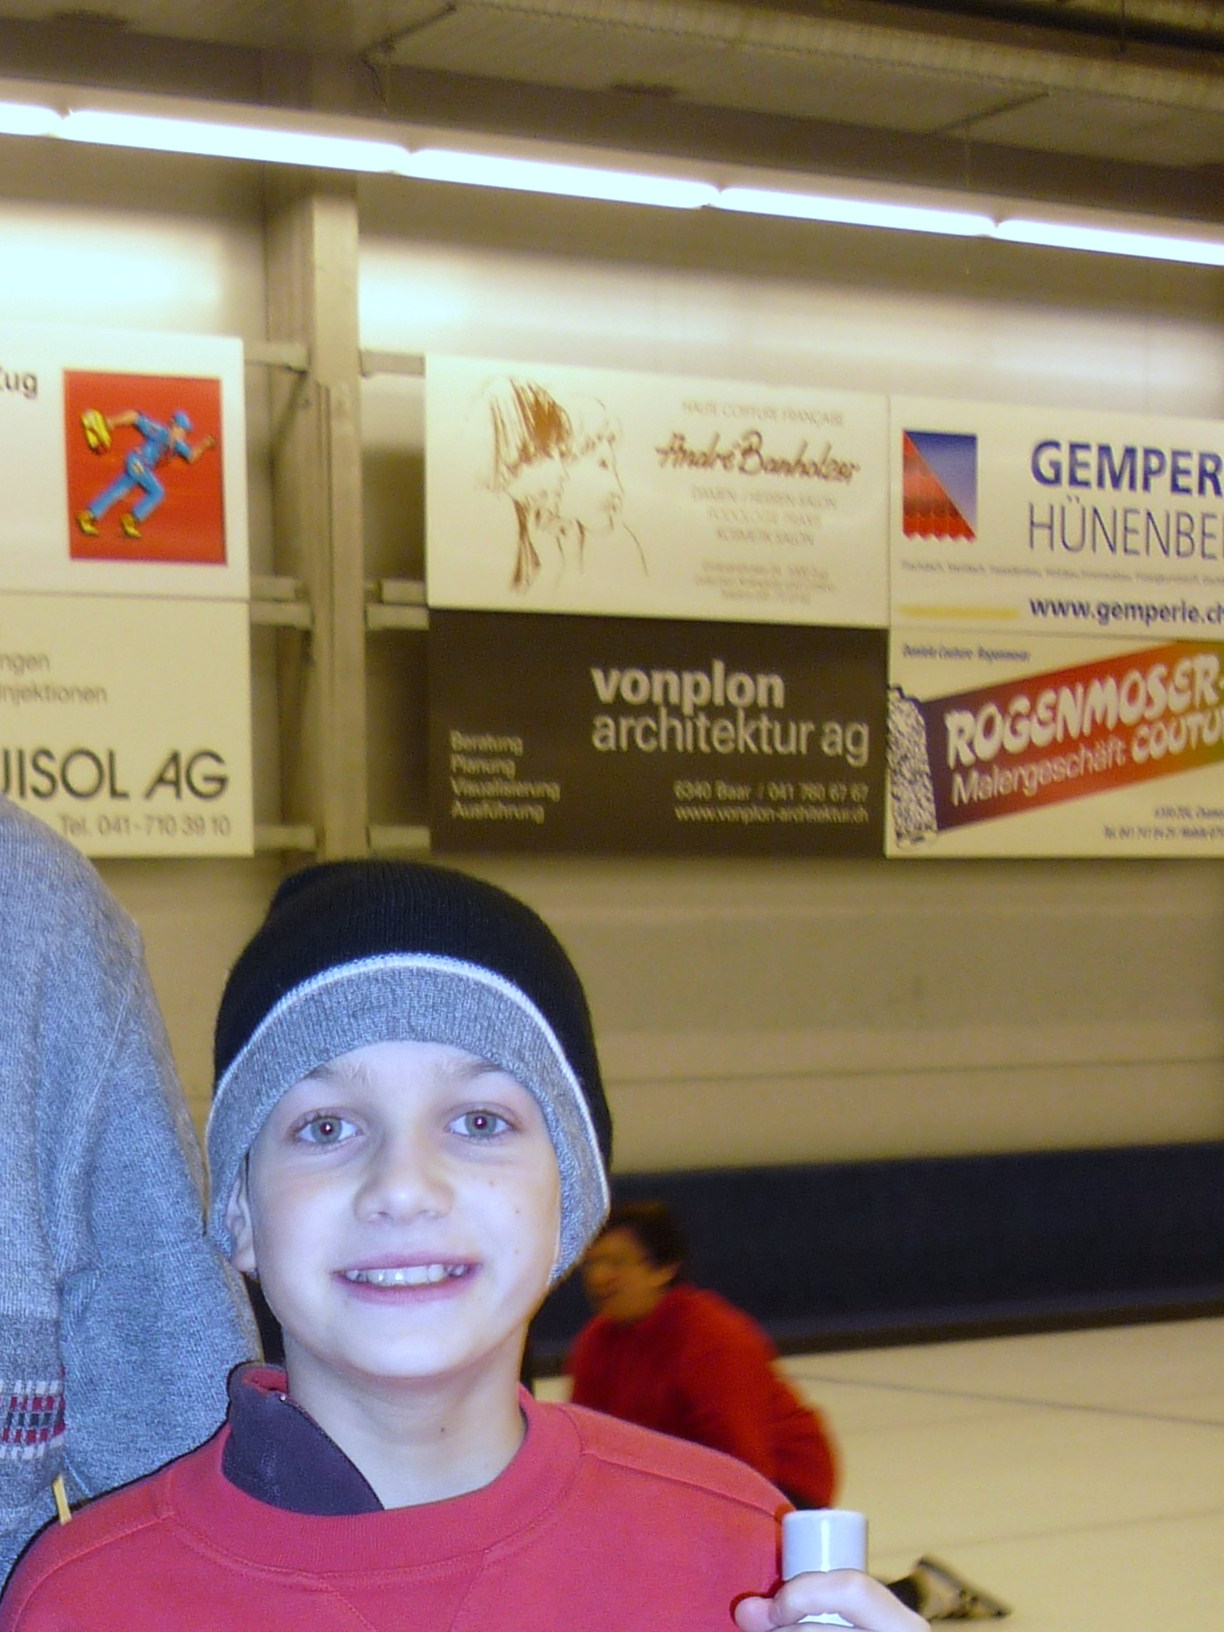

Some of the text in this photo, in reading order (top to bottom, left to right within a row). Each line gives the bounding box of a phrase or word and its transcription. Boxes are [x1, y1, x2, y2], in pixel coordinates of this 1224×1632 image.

[1030, 438, 1224, 499] GEMPER
[1028, 495, 1224, 560] HÜNENBE
[590, 658, 785, 716] vonplon
[591, 706, 870, 768] architektur ag
[1130, 708, 1224, 765] COUTU
[145, 748, 229, 801] AG
